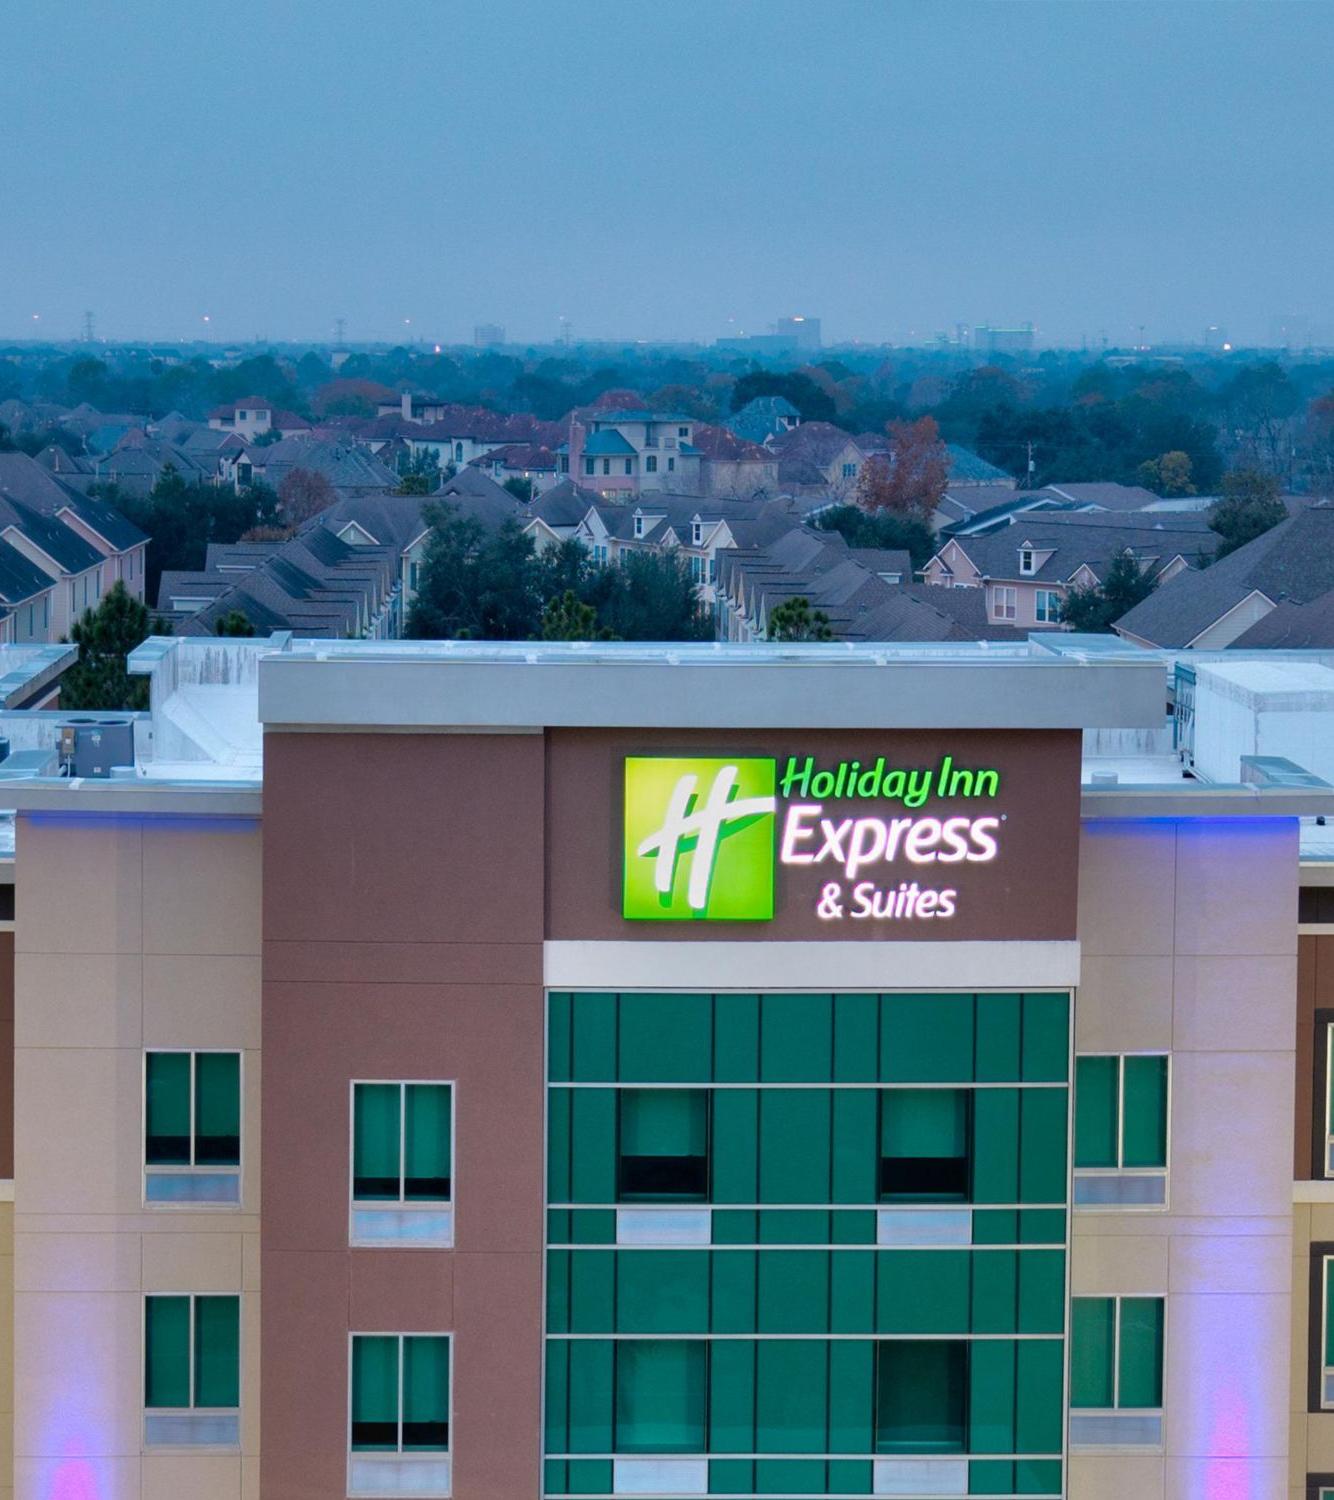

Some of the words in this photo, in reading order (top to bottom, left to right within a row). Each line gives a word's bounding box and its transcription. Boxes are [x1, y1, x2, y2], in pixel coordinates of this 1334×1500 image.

[779, 756, 934, 808] Holiday
[937, 756, 1000, 798] Inn
[780, 804, 1001, 880] Express
[817, 882, 844, 919] &
[850, 882, 958, 919] Suites
